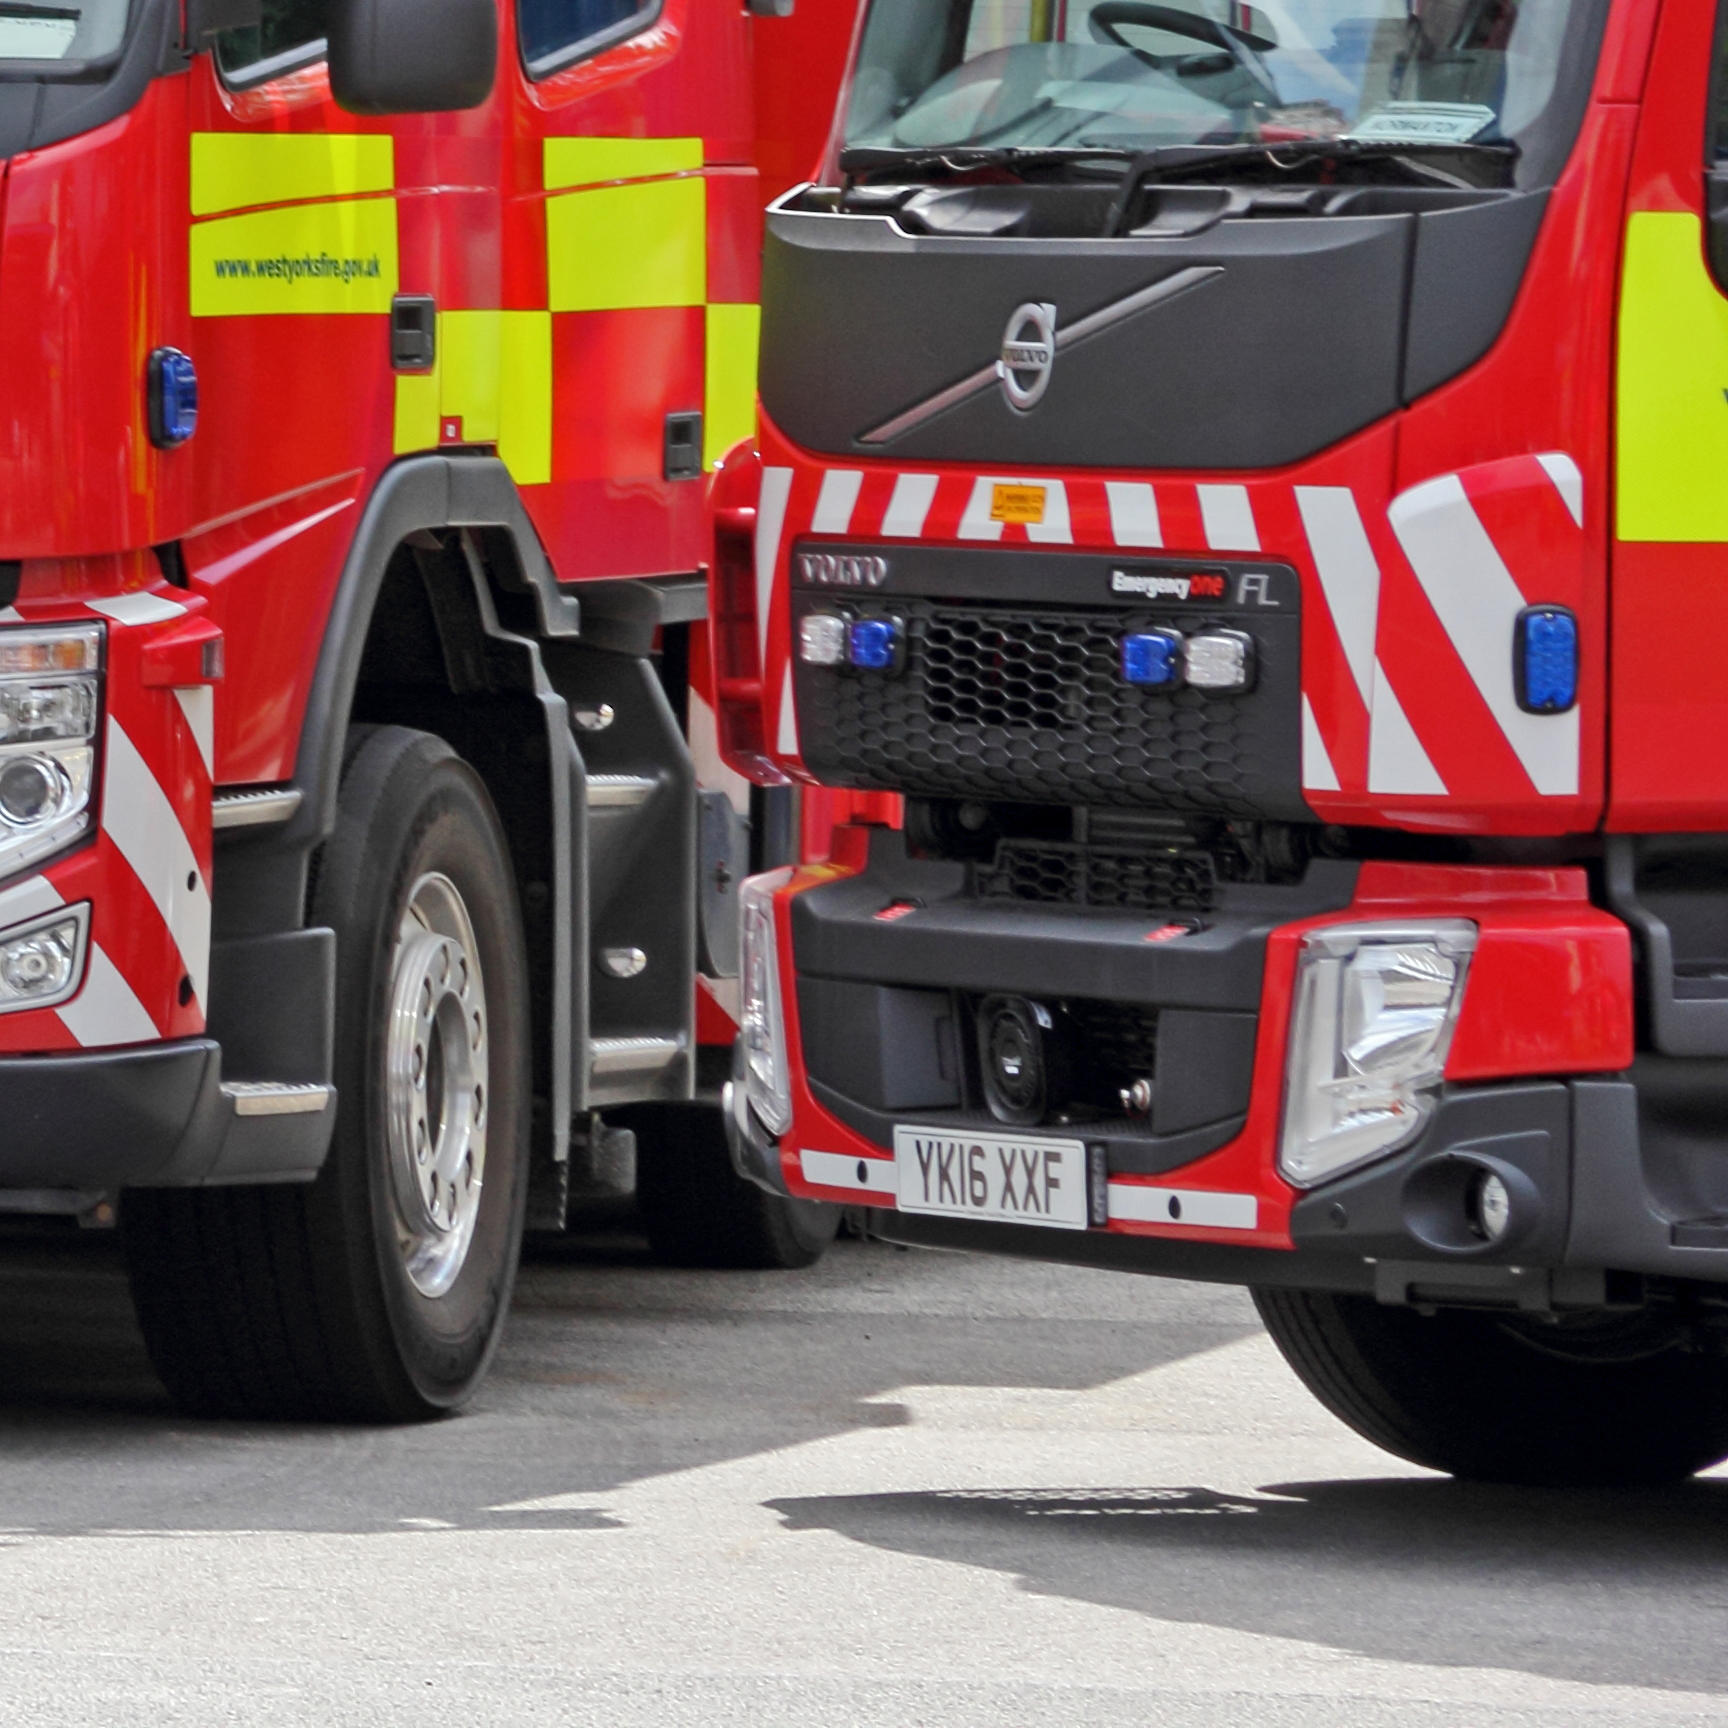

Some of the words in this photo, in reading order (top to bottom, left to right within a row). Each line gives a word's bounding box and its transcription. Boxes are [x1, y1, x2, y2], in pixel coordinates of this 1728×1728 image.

[214, 252, 380, 285] www.westyorksfire.gov.uk
[797, 553, 888, 587] VOLVO
[1237, 573, 1281, 605] FL
[915, 1139, 988, 1208] YK16
[998, 1146, 1063, 1214] XXF
